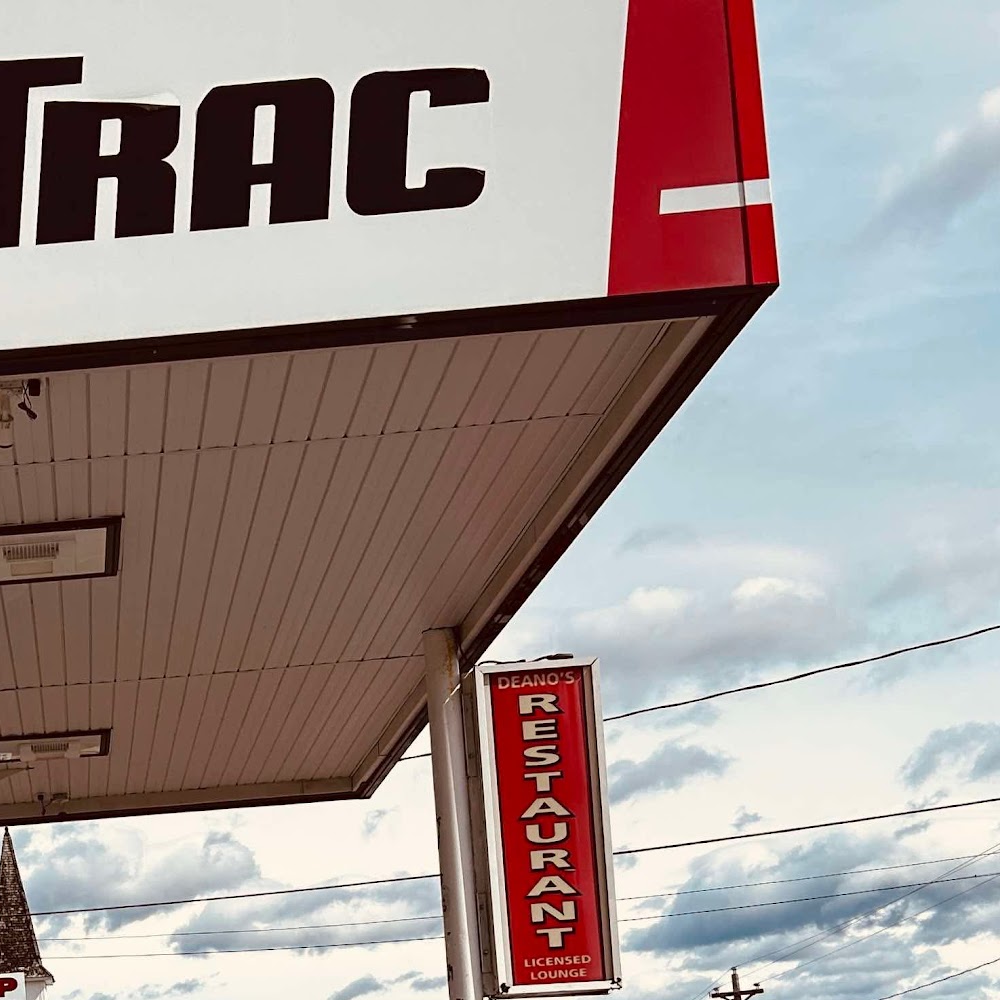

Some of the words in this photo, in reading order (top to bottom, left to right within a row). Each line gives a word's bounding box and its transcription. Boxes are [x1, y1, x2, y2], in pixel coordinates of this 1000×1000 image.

[498, 671, 576, 690] DEANO'S
[517, 692, 580, 949] RESTAURANT
[524, 954, 592, 968] LICENSED
[530, 967, 588, 981] LOUNGE
